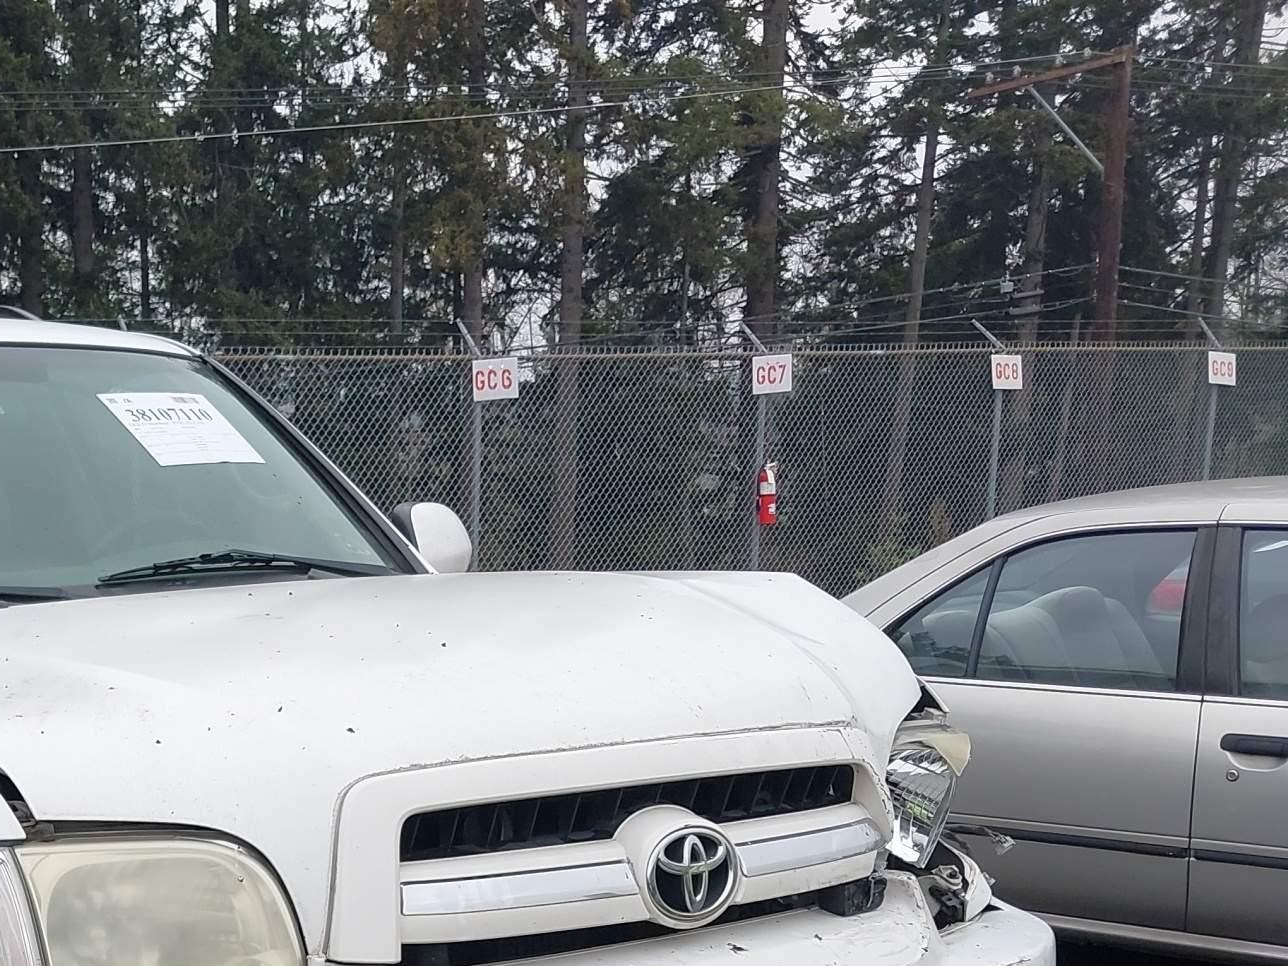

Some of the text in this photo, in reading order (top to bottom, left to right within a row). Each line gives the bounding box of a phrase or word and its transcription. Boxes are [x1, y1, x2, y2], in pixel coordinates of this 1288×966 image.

[756, 364, 786, 385] GC7
[995, 362, 1019, 380] GC8
[1212, 360, 1234, 377] GC9
[475, 369, 513, 391] GC6
[124, 407, 214, 422] 38107110
